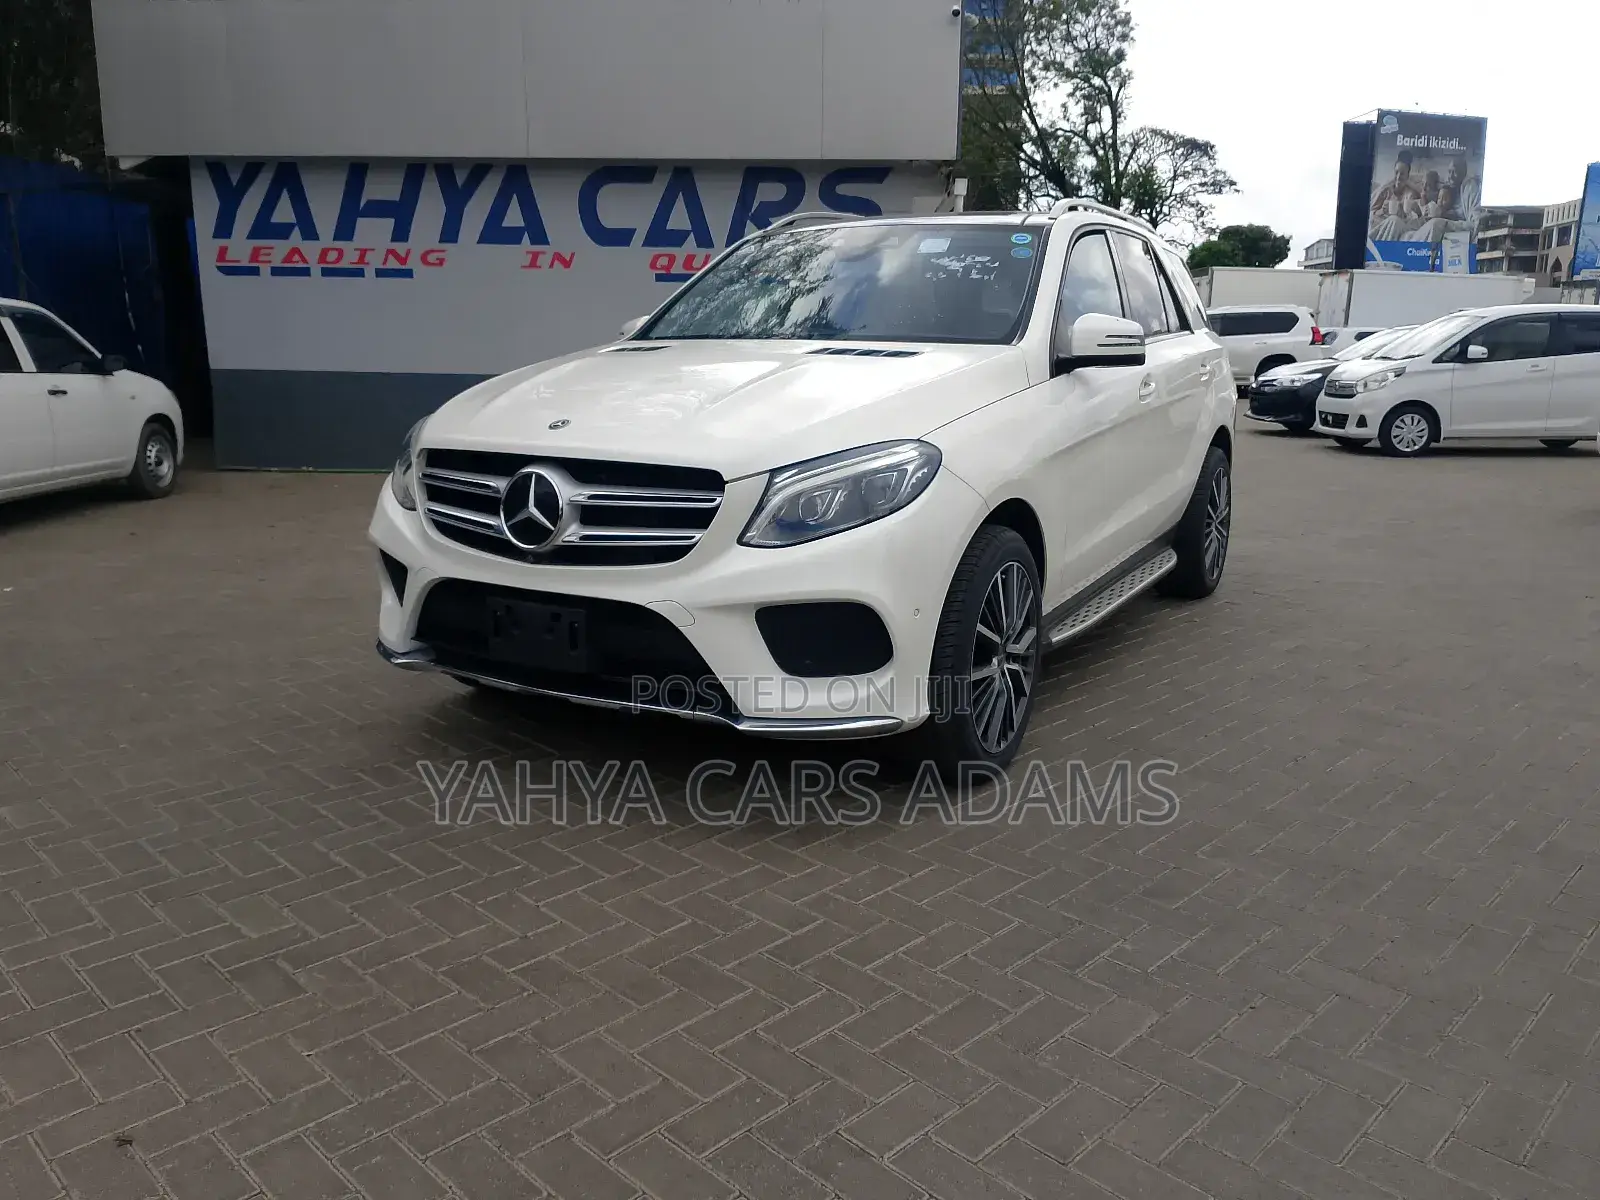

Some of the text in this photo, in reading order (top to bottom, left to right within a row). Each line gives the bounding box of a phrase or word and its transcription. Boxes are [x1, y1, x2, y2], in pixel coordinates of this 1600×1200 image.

[1396, 134, 1427, 147] Baridi
[204, 161, 893, 249] YAHYA CARS
[215, 245, 449, 268] LEADING
[520, 251, 576, 270] IN
